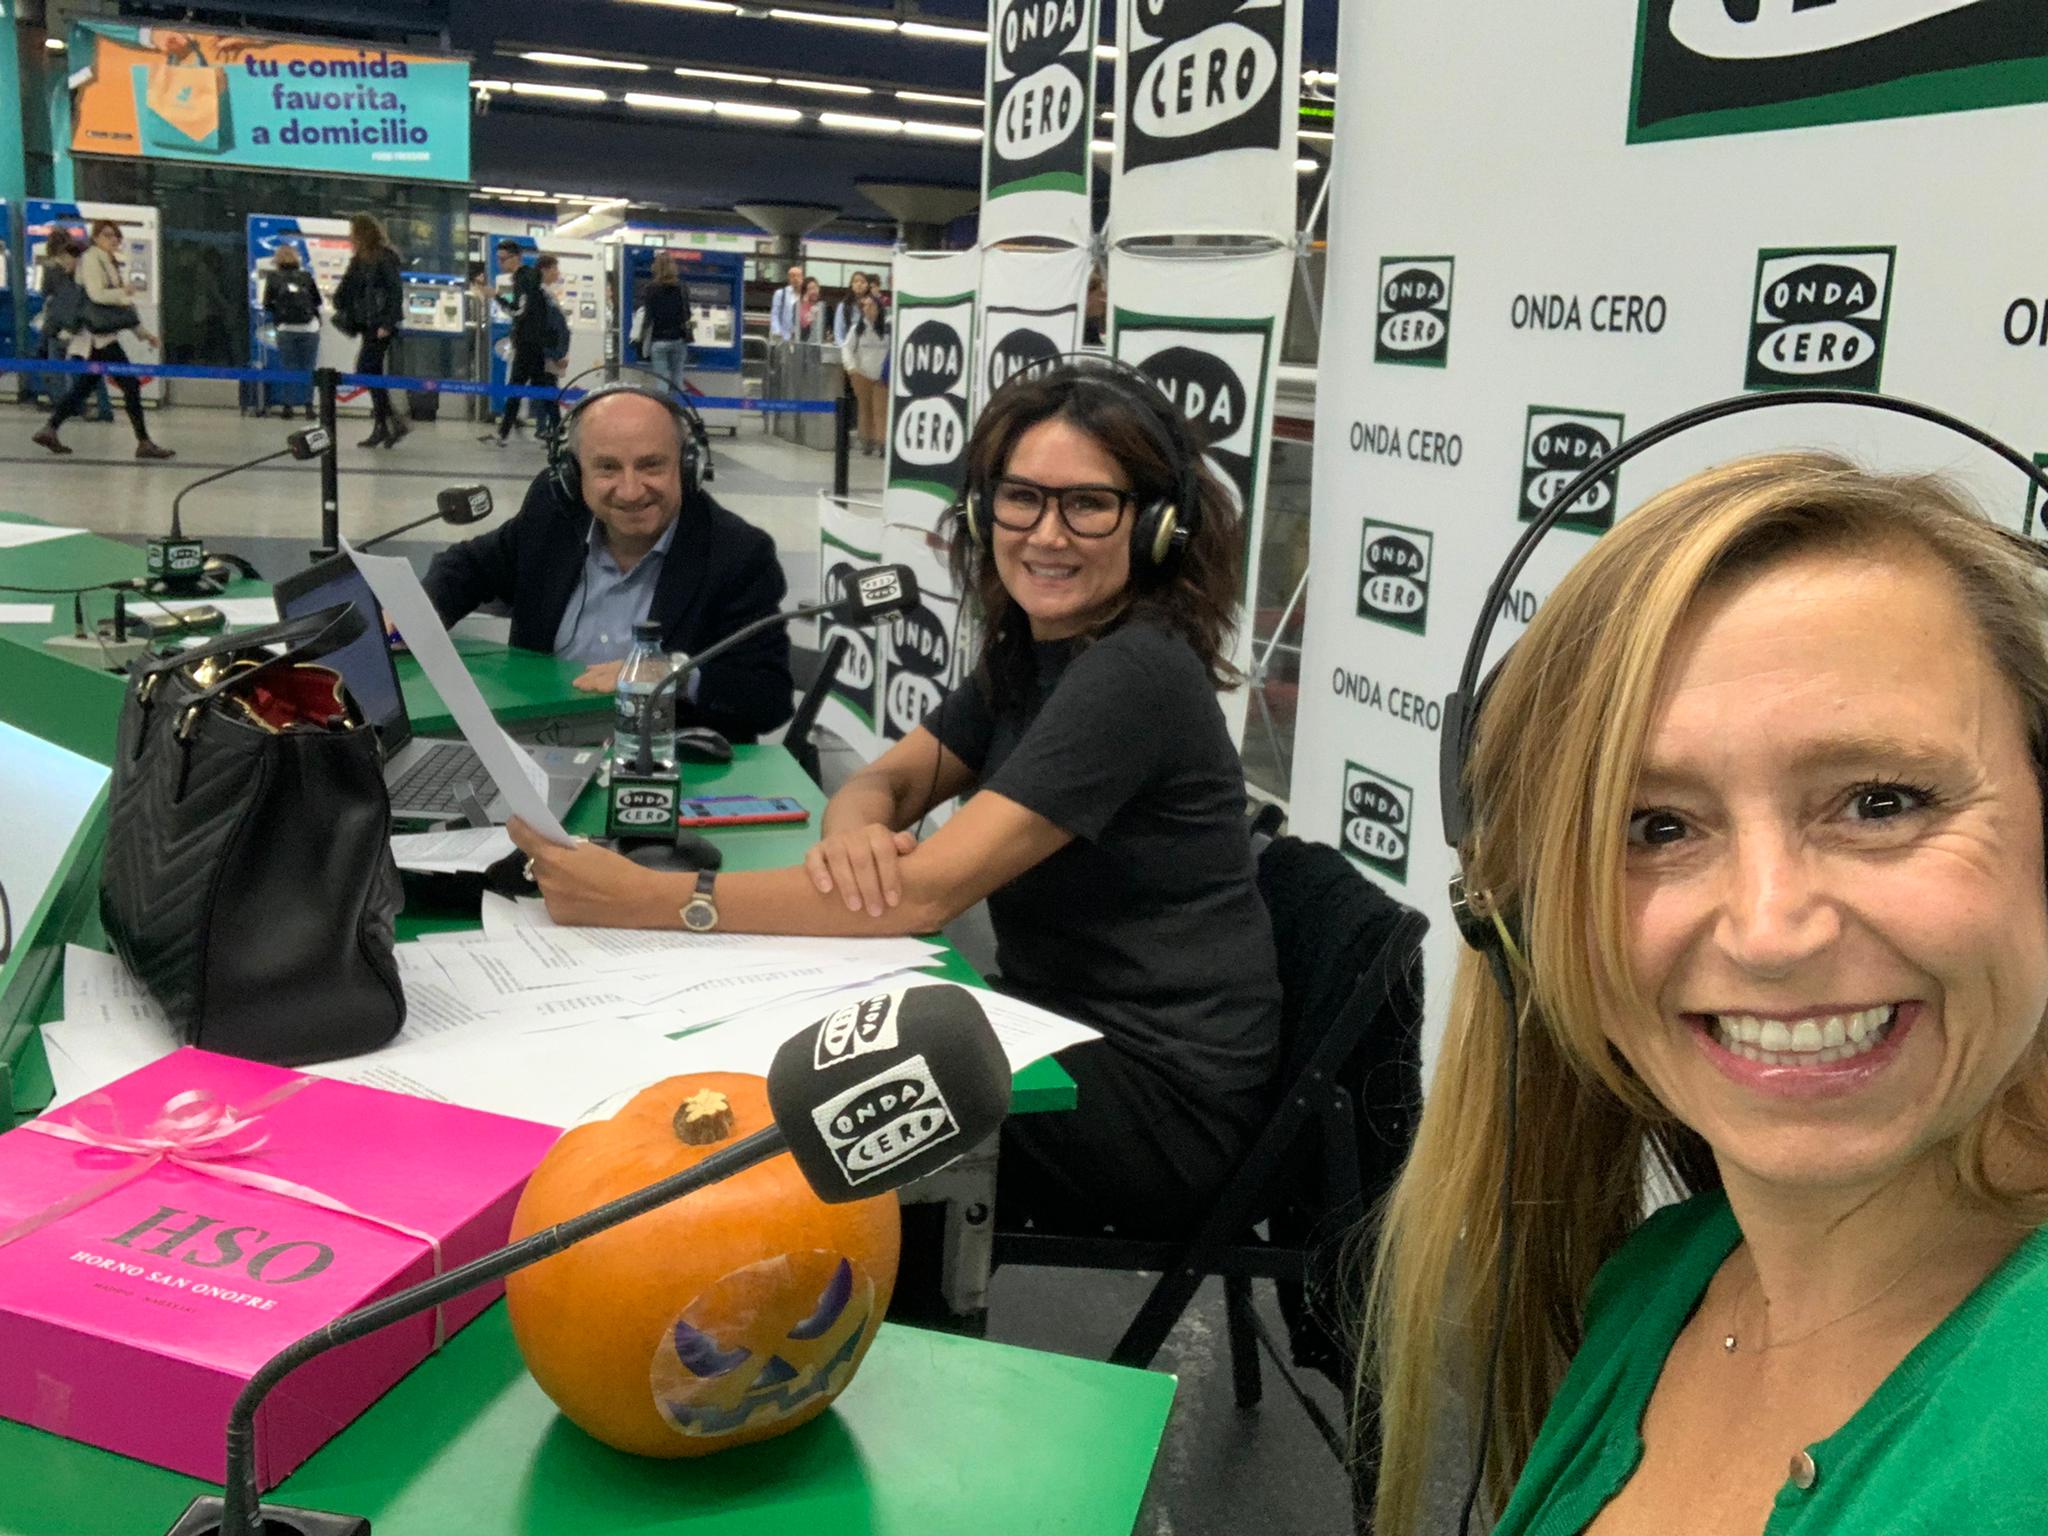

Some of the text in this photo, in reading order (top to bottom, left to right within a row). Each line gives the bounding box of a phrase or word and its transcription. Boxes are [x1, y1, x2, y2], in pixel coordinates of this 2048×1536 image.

[1005, 1, 1076, 53] ONDA
[245, 50, 408, 78] tu comida
[272, 83, 406, 113] favorita,
[1152, 47, 1256, 118] CERO
[1006, 85, 1072, 143] CERO
[252, 118, 428, 144] a domicilio
[1389, 282, 1440, 299] ONDA
[1774, 281, 1865, 308] ONDA
[1512, 294, 1667, 333] ONDA CERO
[1389, 319, 1436, 342] CERO
[904, 343, 958, 377] ONDA
[1773, 332, 1860, 362] CERO
[905, 411, 955, 454] CERO
[1350, 421, 1462, 466] ONDA CERO
[1538, 435, 1602, 460] ONDA
[1538, 477, 1599, 506] CEO
[1371, 542, 1419, 569] ONDA
[1371, 578, 1415, 608] CERO
[1333, 667, 1441, 731] ONDA CERO
[623, 795, 665, 804] ONDA
[625, 810, 663, 820] CERO
[1353, 790, 1399, 821] ONDA
[1352, 821, 1397, 856] CERO
[836, 1084, 918, 1134] ONDA
[858, 1115, 933, 1161] CERO
[102, 1205, 335, 1284] HSO
[69, 1251, 144, 1276] HORNO
[145, 1271, 192, 1289] SAN
[191, 1283, 278, 1311] ONOFRE
